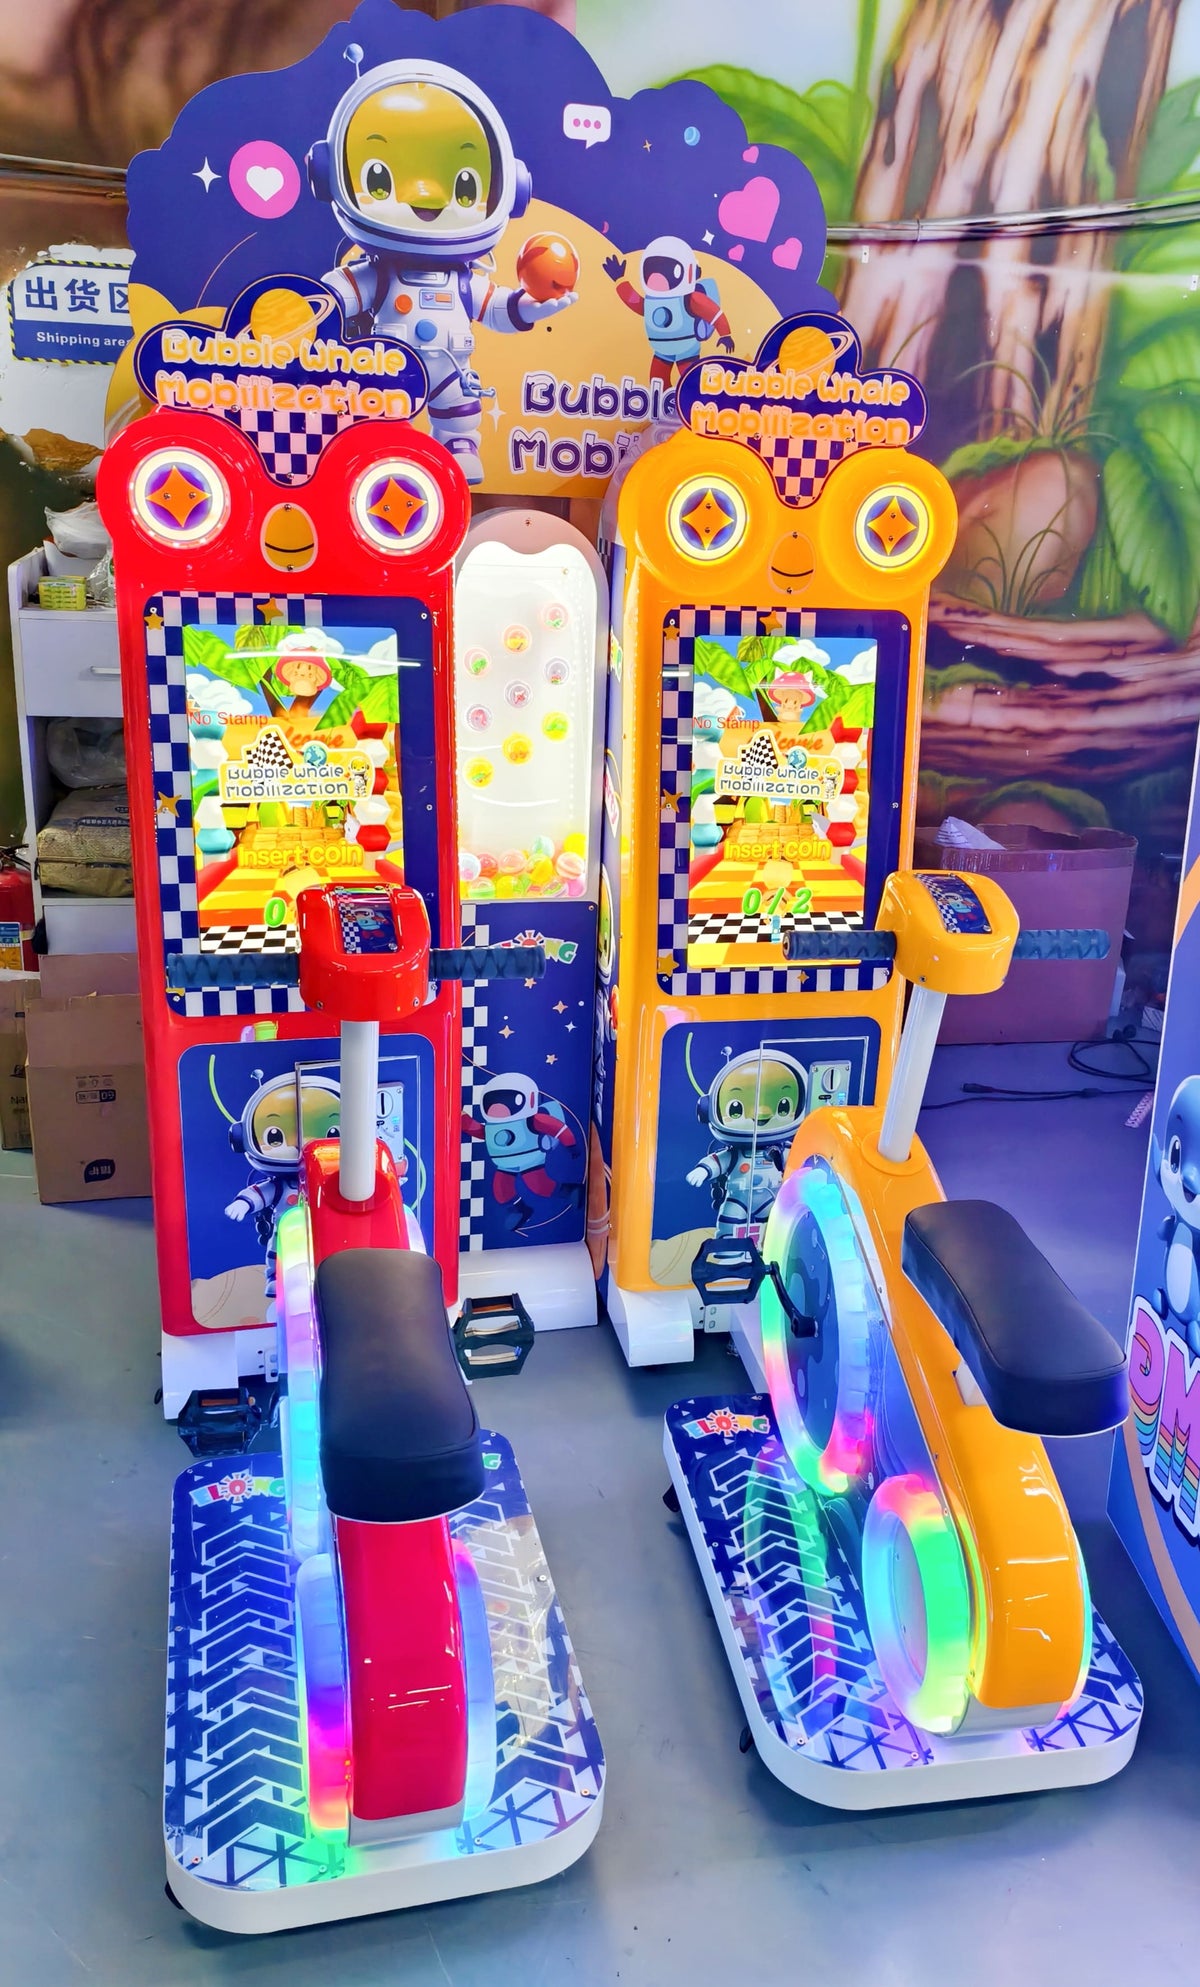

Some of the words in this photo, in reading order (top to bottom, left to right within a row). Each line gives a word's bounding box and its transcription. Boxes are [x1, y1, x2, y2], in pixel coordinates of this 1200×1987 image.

[25, 276, 130, 314] 出货区
[36, 331, 100, 347] Shipping
[103, 337, 131, 347] are
[161, 328, 297, 367] Bubble
[299, 337, 407, 376] Whale
[153, 370, 411, 419] Mobilization
[698, 363, 812, 400] Bubble
[816, 371, 911, 407] Whale
[690, 401, 912, 445] Mobilization
[189, 711, 211, 726] No
[217, 711, 269, 727] Stamp
[692, 716, 712, 730] No
[716, 716, 761, 732] Stamp
[227, 765, 290, 780] Bubble
[723, 763, 774, 778] Bubble
[225, 780, 349, 798] Mobilization
[719, 777, 821, 796] Mobilization
[238, 845, 304, 868] Insert
[724, 840, 781, 860] Insert
[682, 1406, 770, 1440] ELONG
